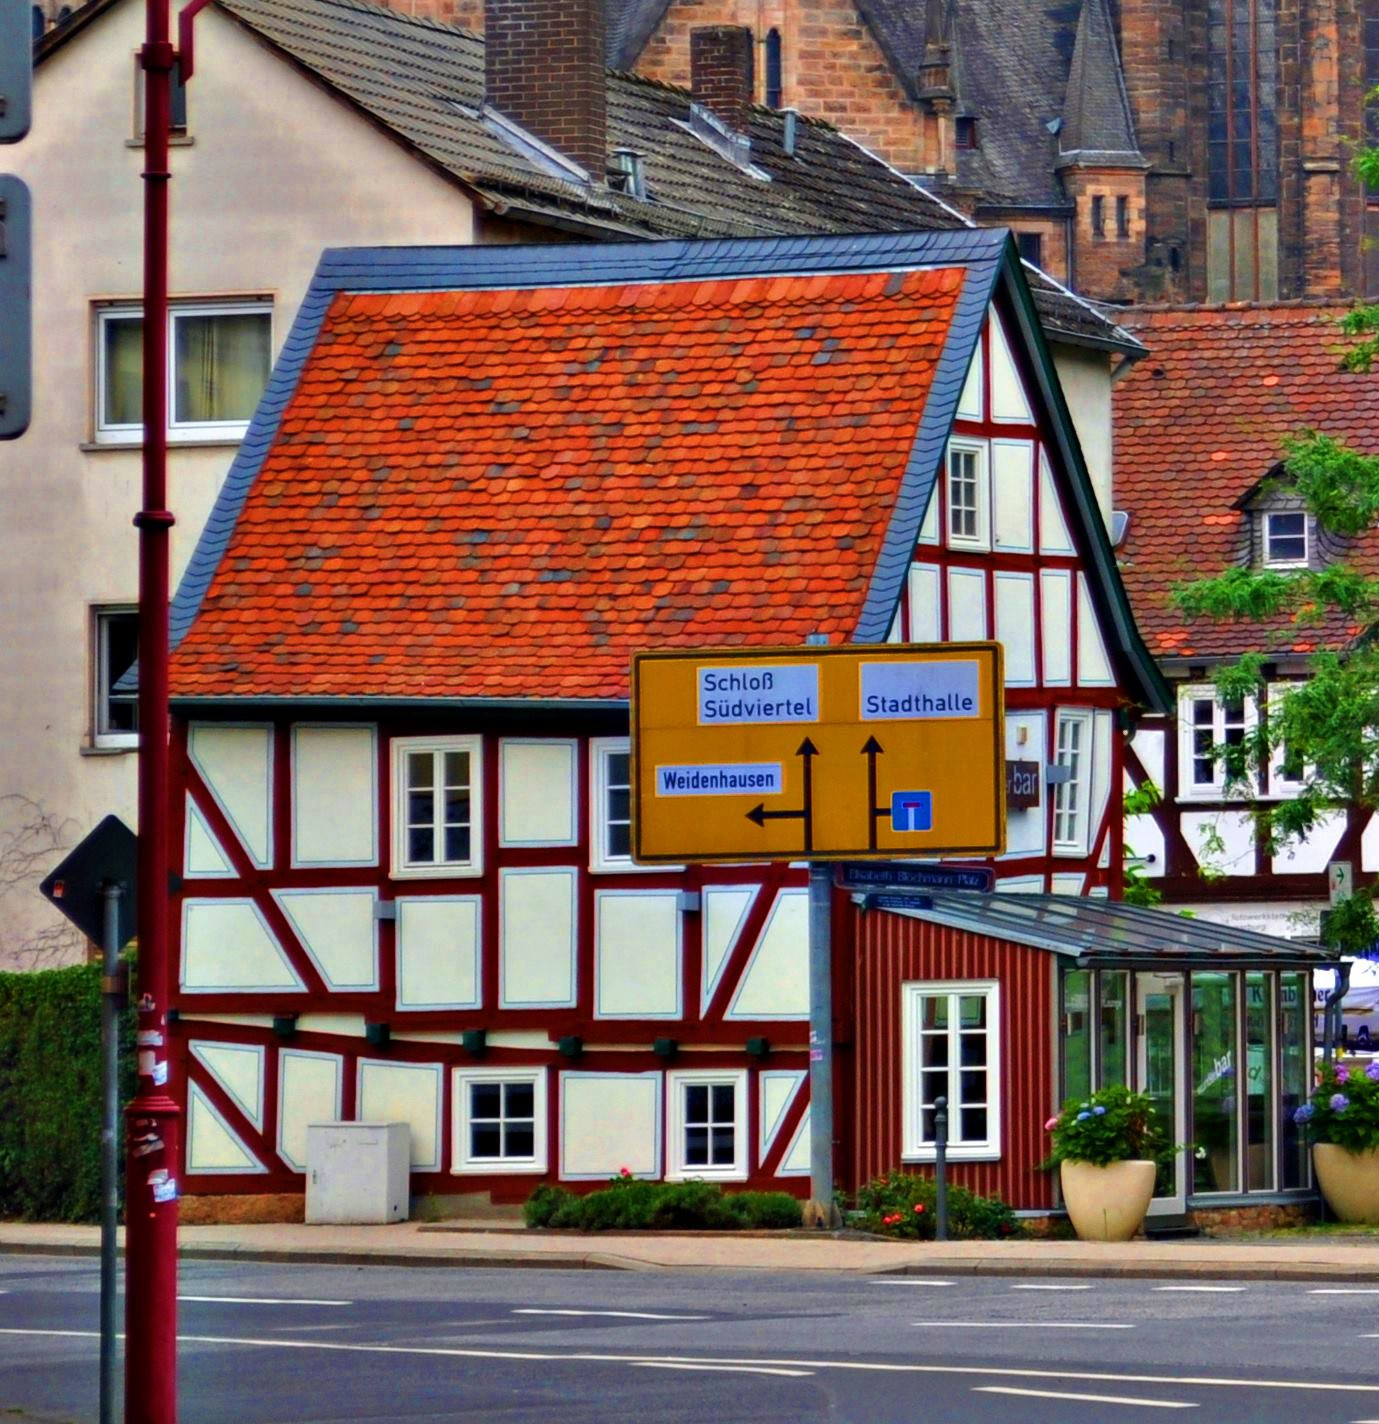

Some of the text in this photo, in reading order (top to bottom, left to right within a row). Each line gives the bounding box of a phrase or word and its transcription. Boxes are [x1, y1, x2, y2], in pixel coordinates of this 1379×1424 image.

[703, 672, 774, 693] Schloß
[703, 696, 813, 719] Südviertel
[866, 693, 974, 714] Stadthalle
[663, 771, 775, 792] Weidenhausen
